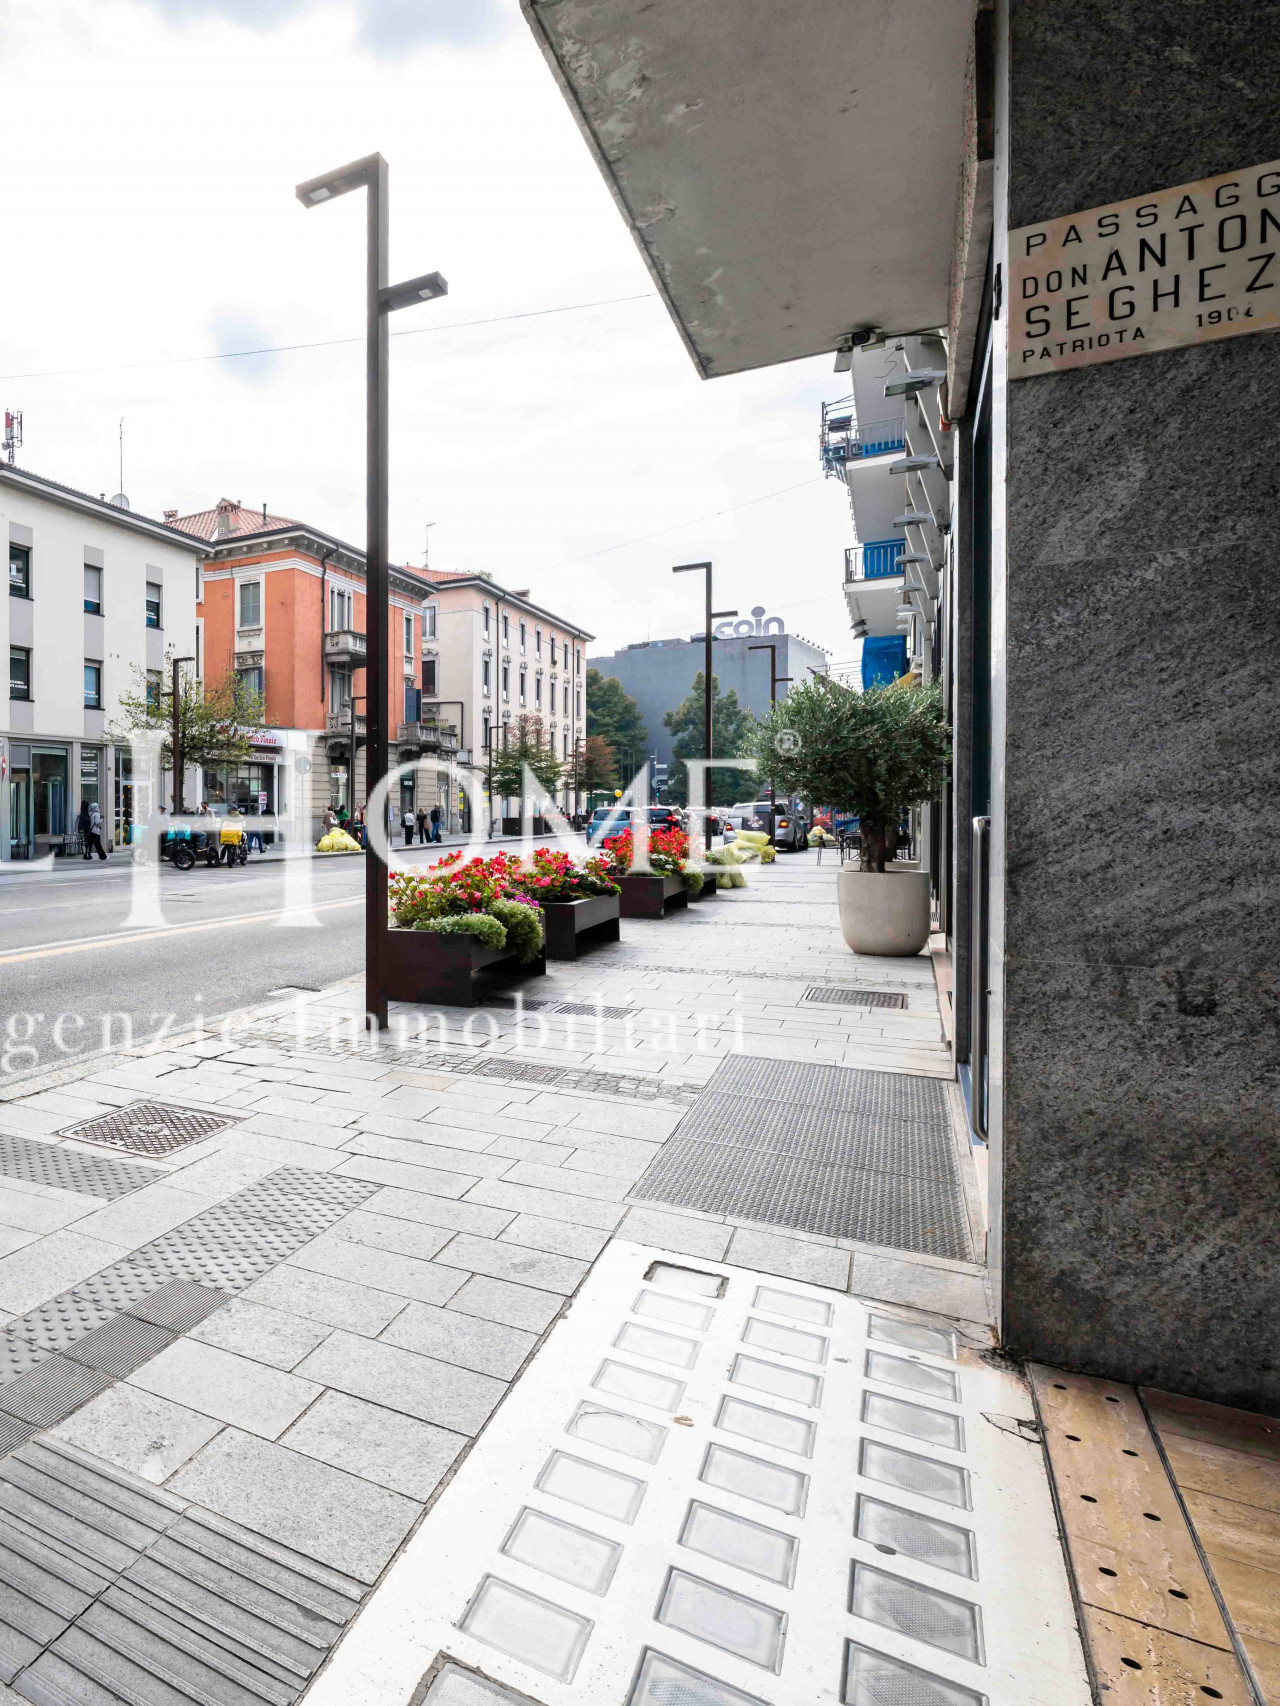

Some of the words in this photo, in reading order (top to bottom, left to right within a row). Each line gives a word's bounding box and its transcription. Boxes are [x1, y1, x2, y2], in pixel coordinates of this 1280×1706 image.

[1022, 264, 1088, 299] DON
[1025, 252, 1275, 339] SEGHEZ
[1022, 326, 1146, 363] PATRIOTA
